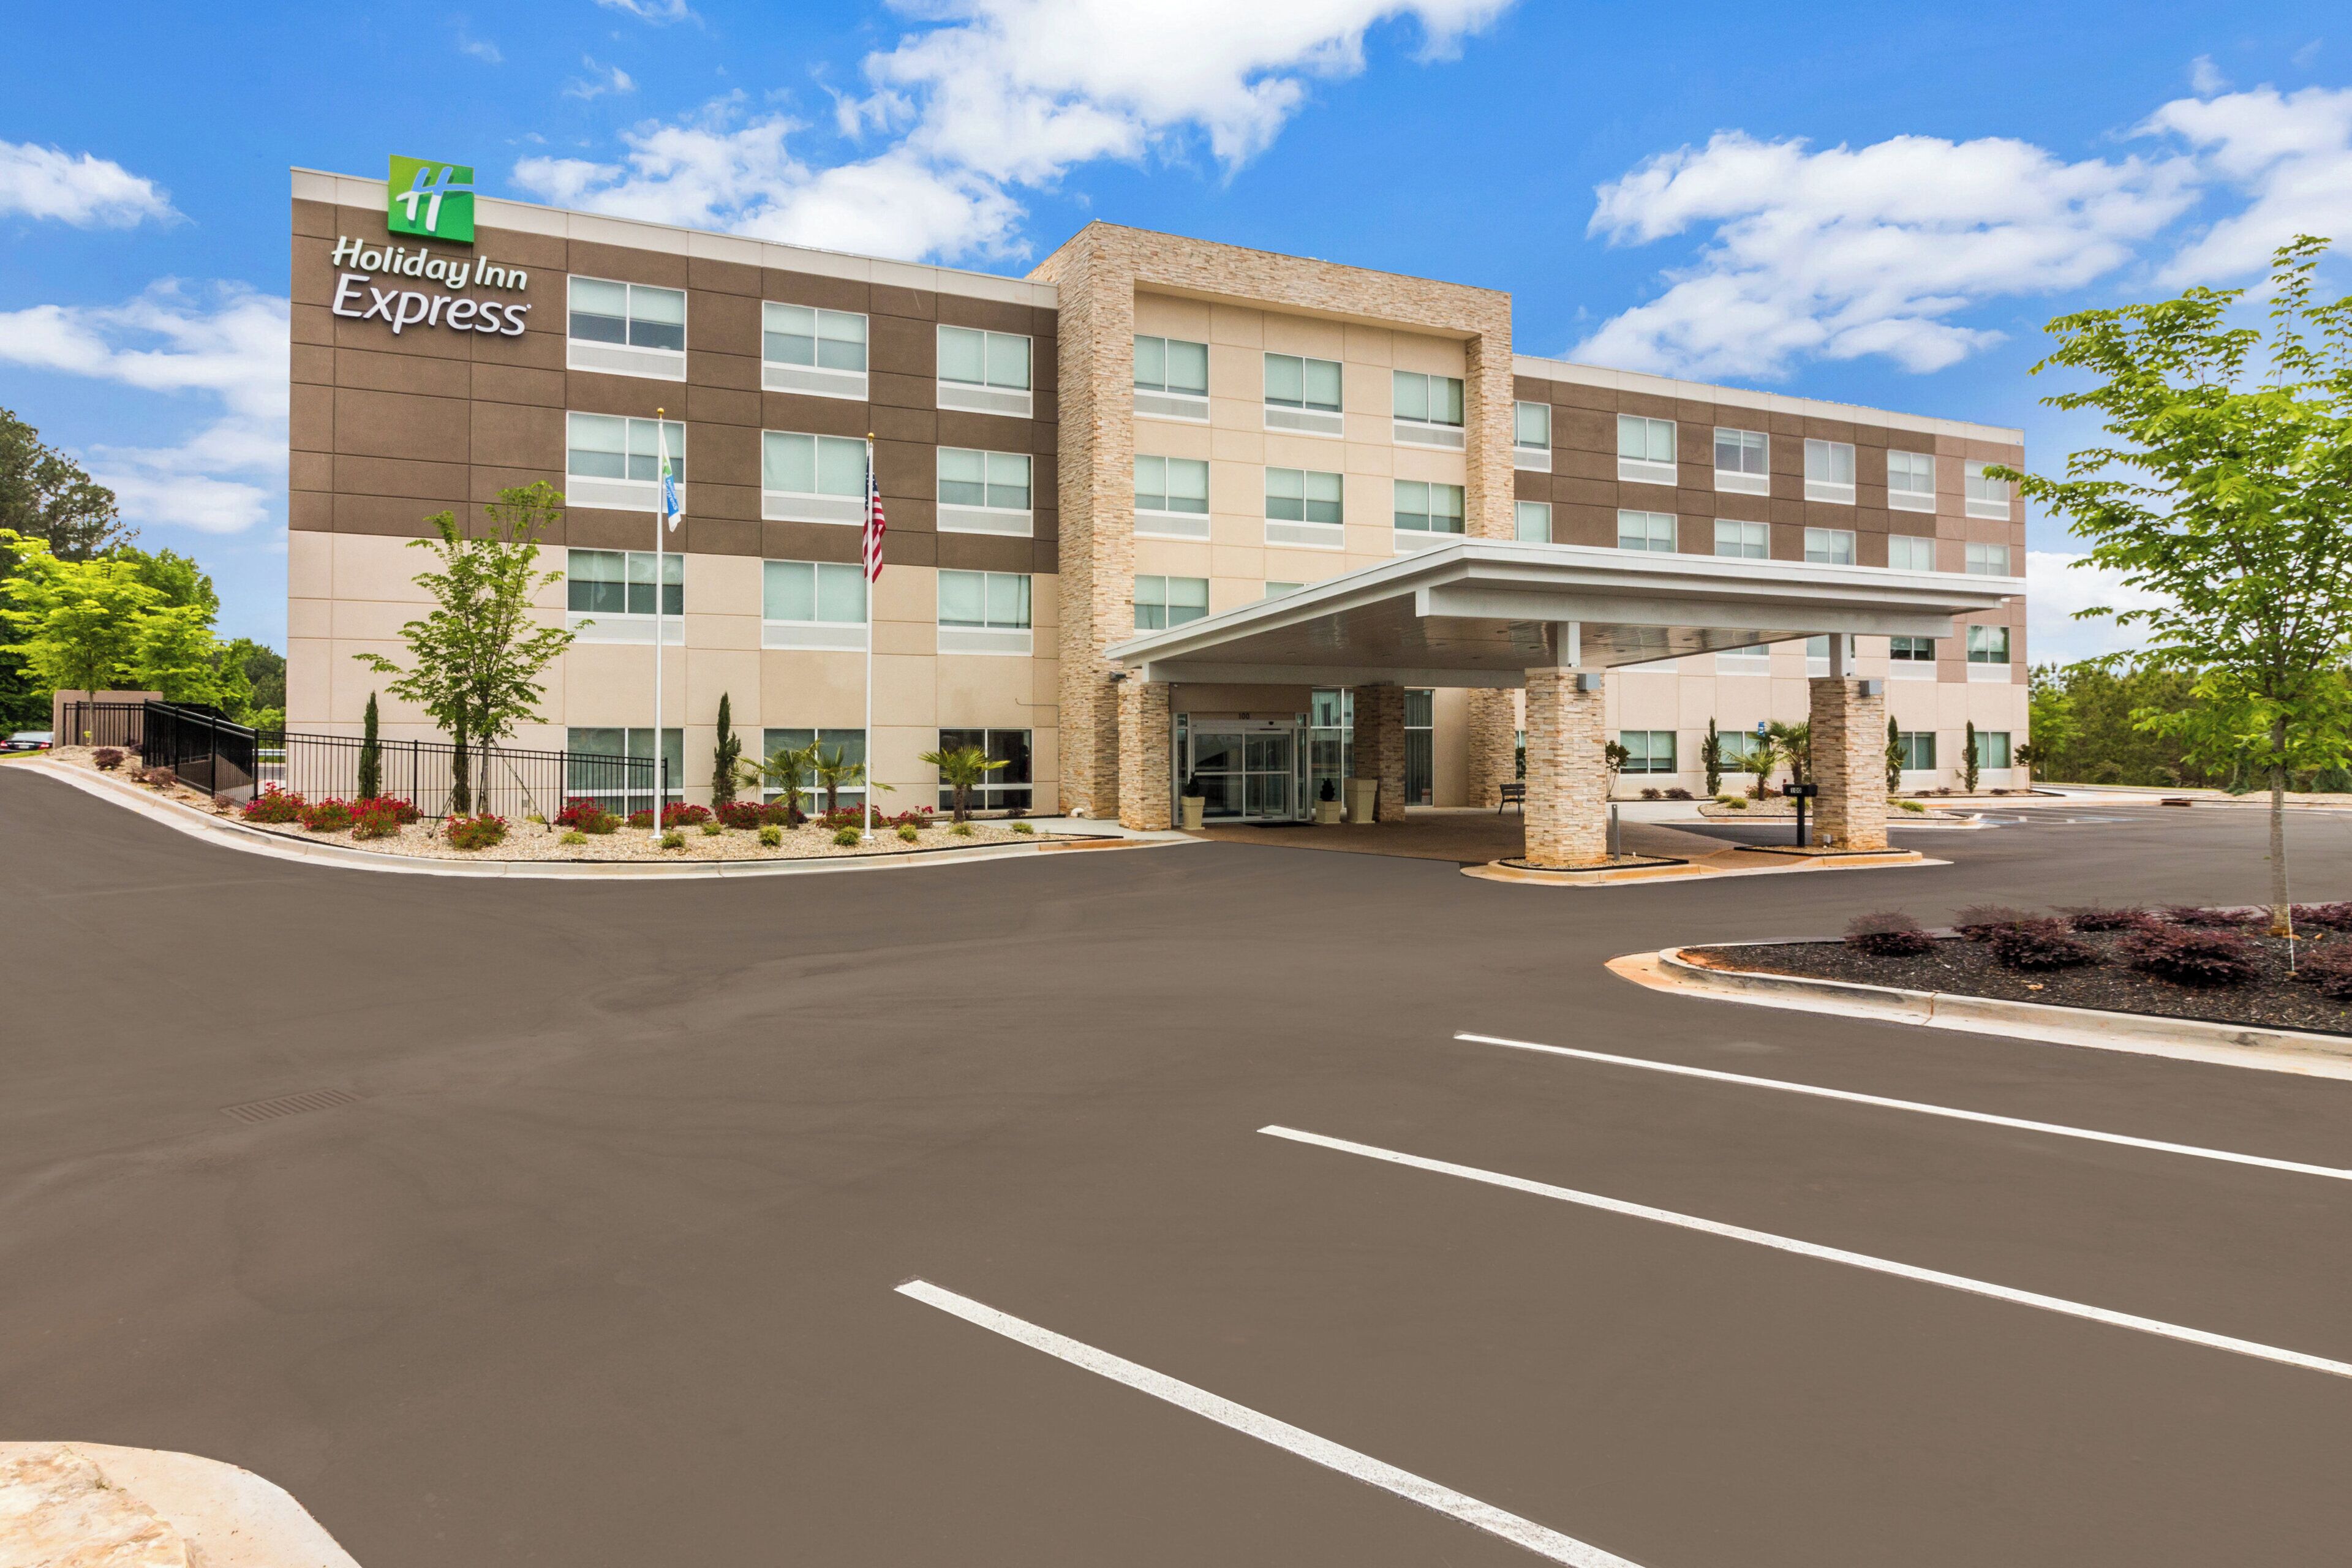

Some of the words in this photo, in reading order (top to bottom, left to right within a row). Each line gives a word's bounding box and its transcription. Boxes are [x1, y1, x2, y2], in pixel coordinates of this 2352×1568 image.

[331, 236, 470, 289] Holiday
[475, 255, 528, 290] Inn
[333, 273, 527, 336] Express
